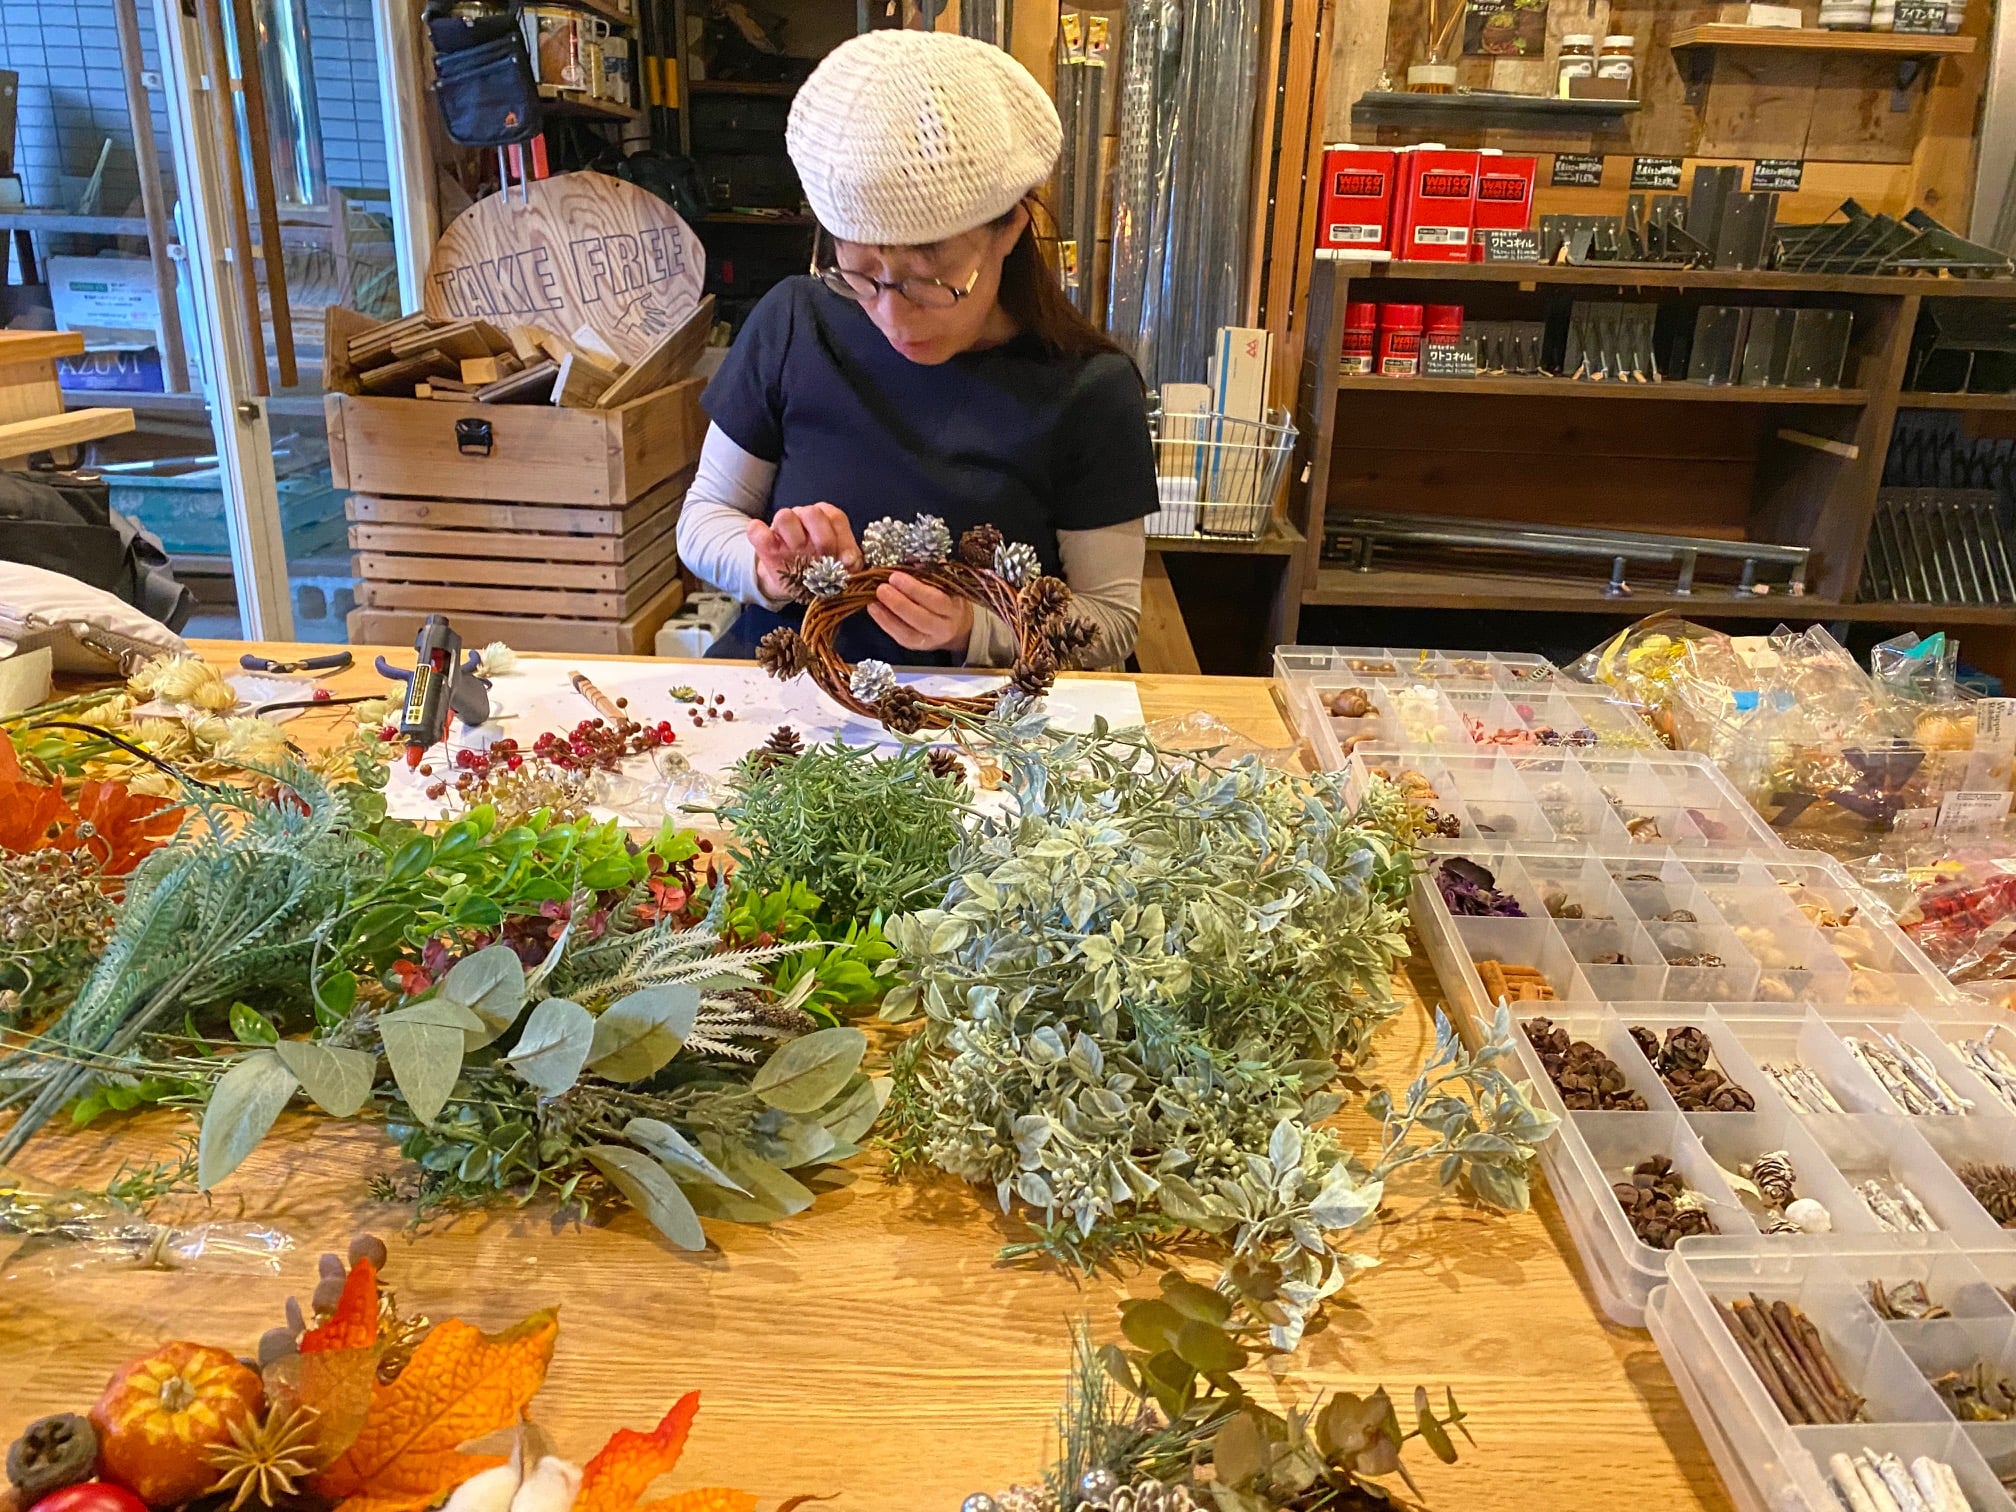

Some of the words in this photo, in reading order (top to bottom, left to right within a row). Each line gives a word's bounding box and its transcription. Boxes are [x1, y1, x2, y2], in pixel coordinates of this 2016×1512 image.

[1339, 174, 1381, 186] WATCO
[1425, 175, 1468, 187] WATCO
[1491, 237, 1535, 248] ワトコオイル
[434, 246, 564, 317] TAKE
[569, 225, 686, 304] FREE
[1430, 351, 1474, 362] ワトコオイル
[60, 354, 141, 375] AZUVI
